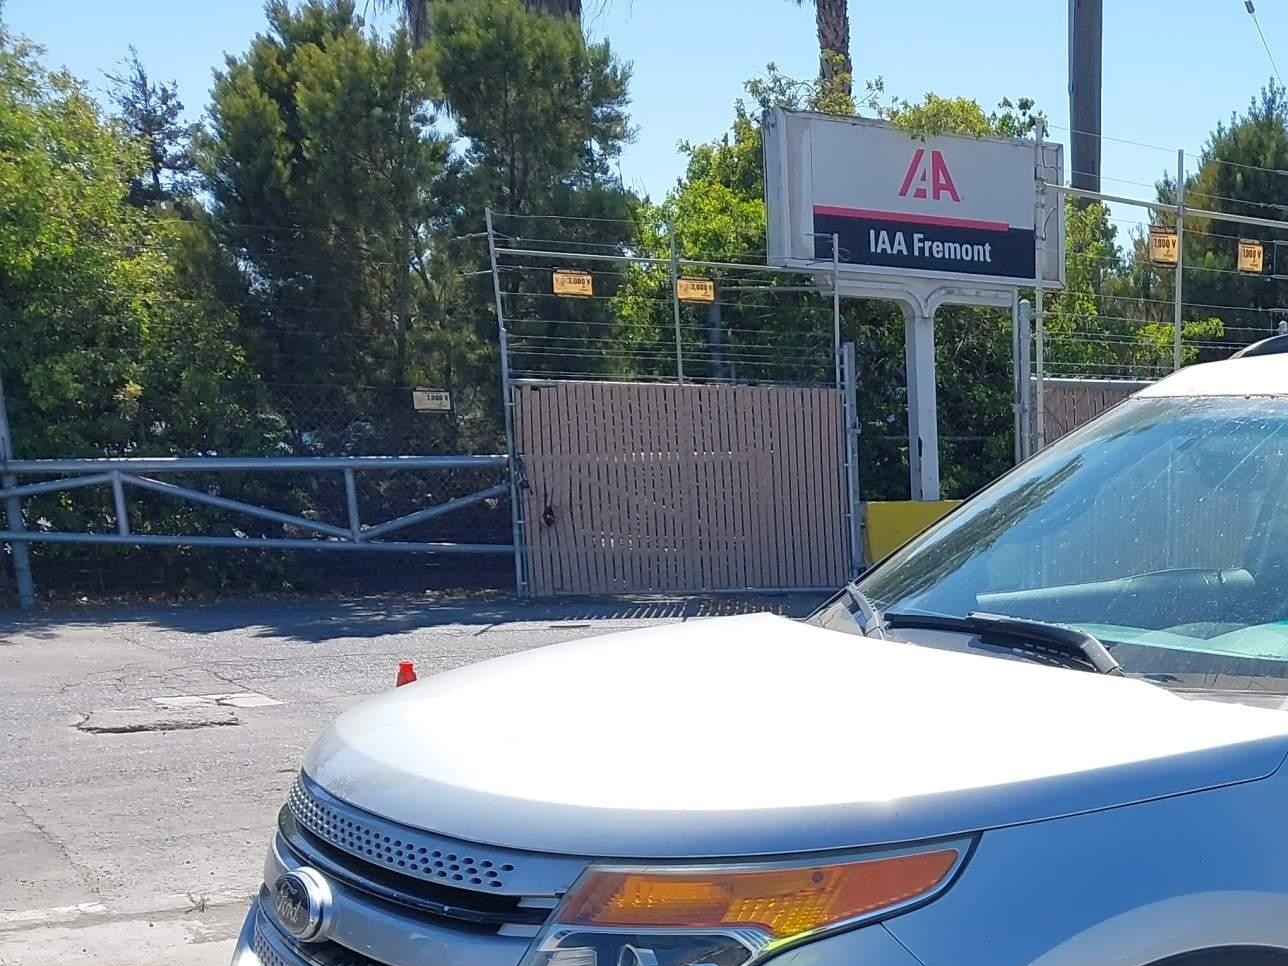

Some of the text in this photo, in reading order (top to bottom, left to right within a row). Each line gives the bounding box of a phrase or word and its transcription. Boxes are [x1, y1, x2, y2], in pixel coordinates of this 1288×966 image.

[869, 229, 992, 262] IAA Fremont
[1171, 239, 1177, 249] V
[1257, 250, 1262, 259] V
